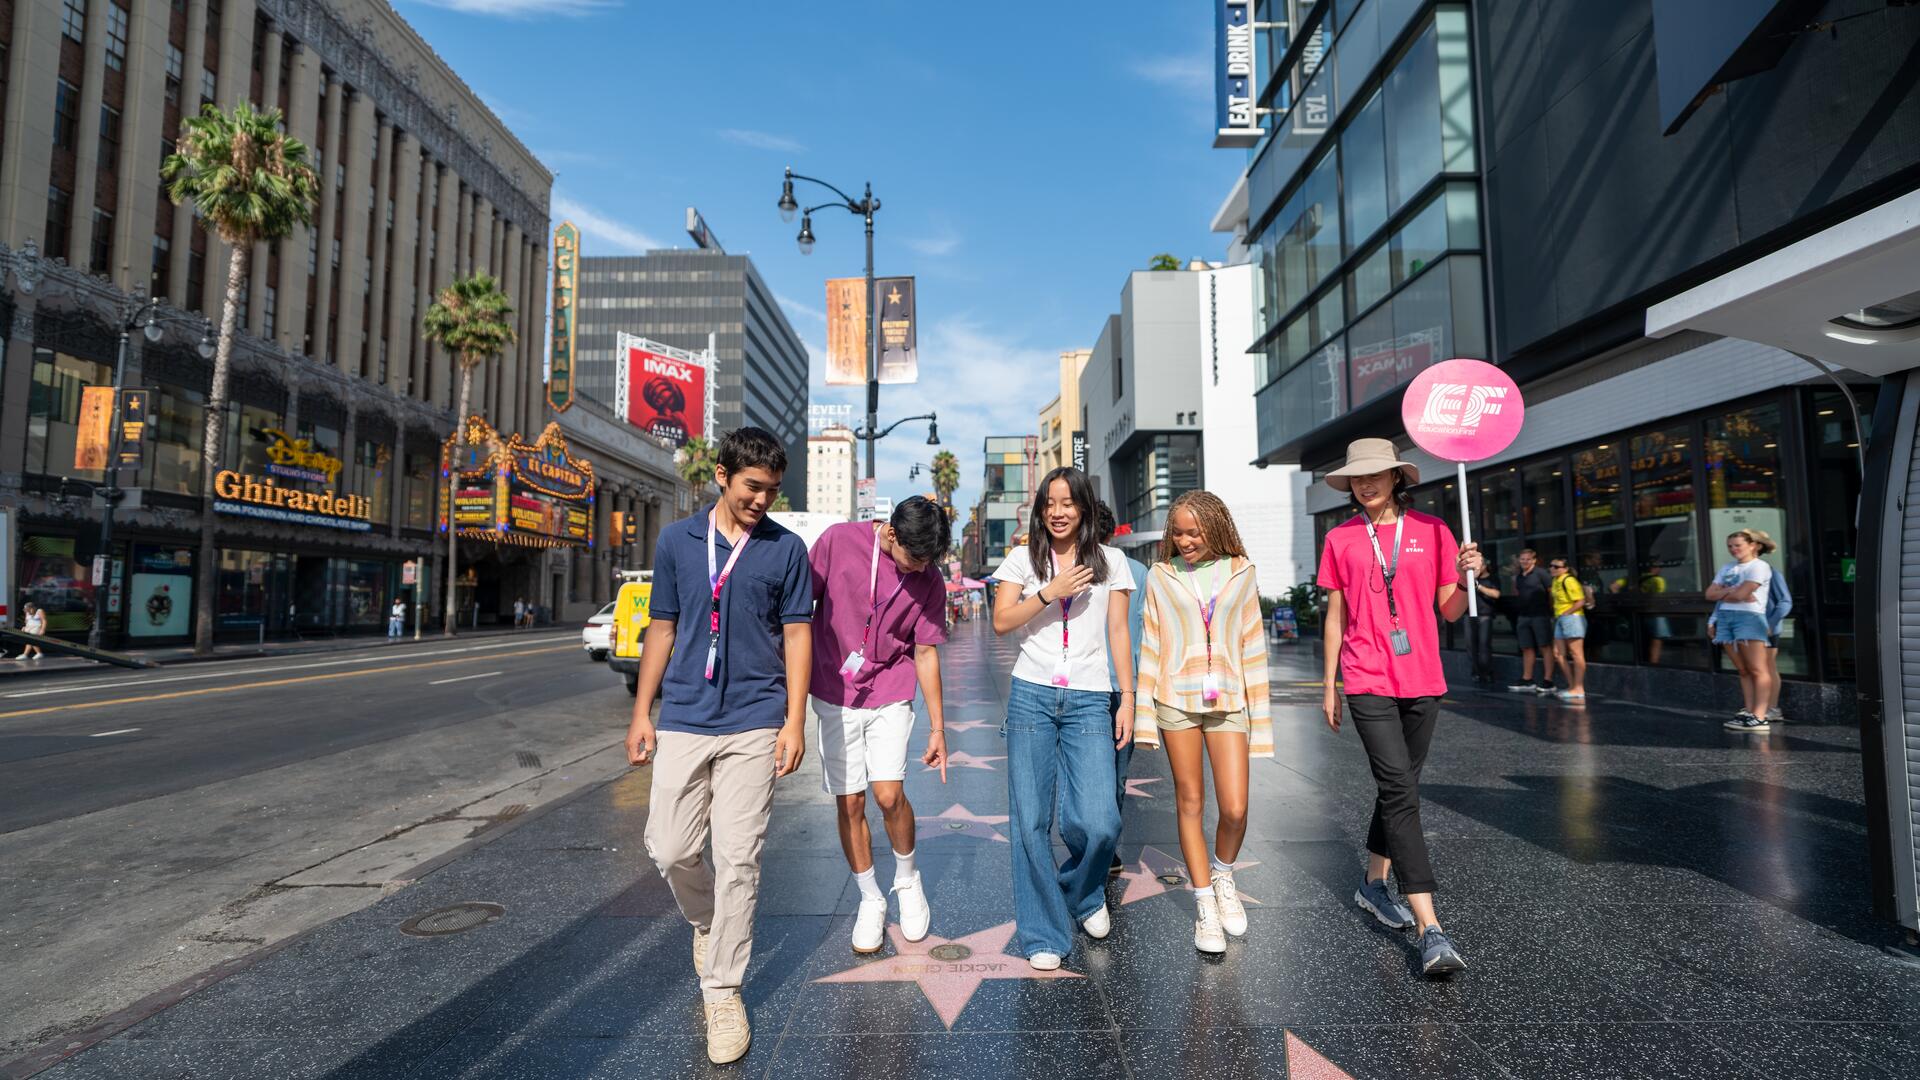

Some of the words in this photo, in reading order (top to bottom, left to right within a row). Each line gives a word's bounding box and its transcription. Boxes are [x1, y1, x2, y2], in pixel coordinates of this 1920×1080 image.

[1227, 23, 1249, 74] DRINK
[1228, 95, 1249, 125] EAT
[556, 236, 572, 250] EL
[553, 254, 572, 393] CAPITAN
[643, 358, 693, 383] IMAX
[808, 404, 853, 415] EVELT
[1421, 383, 1508, 427] EF
[1418, 424, 1459, 435] Education
[1459, 427, 1476, 436] First
[528, 457, 541, 474] EL
[215, 469, 370, 519] Ghirardelli
[213, 502, 240, 512] SODA
[242, 505, 286, 520] FOUNTAIN
[287, 512, 305, 523] AND
[306, 515, 350, 528] CHOCOLATE
[950, 963, 1008, 973] JACKIE
